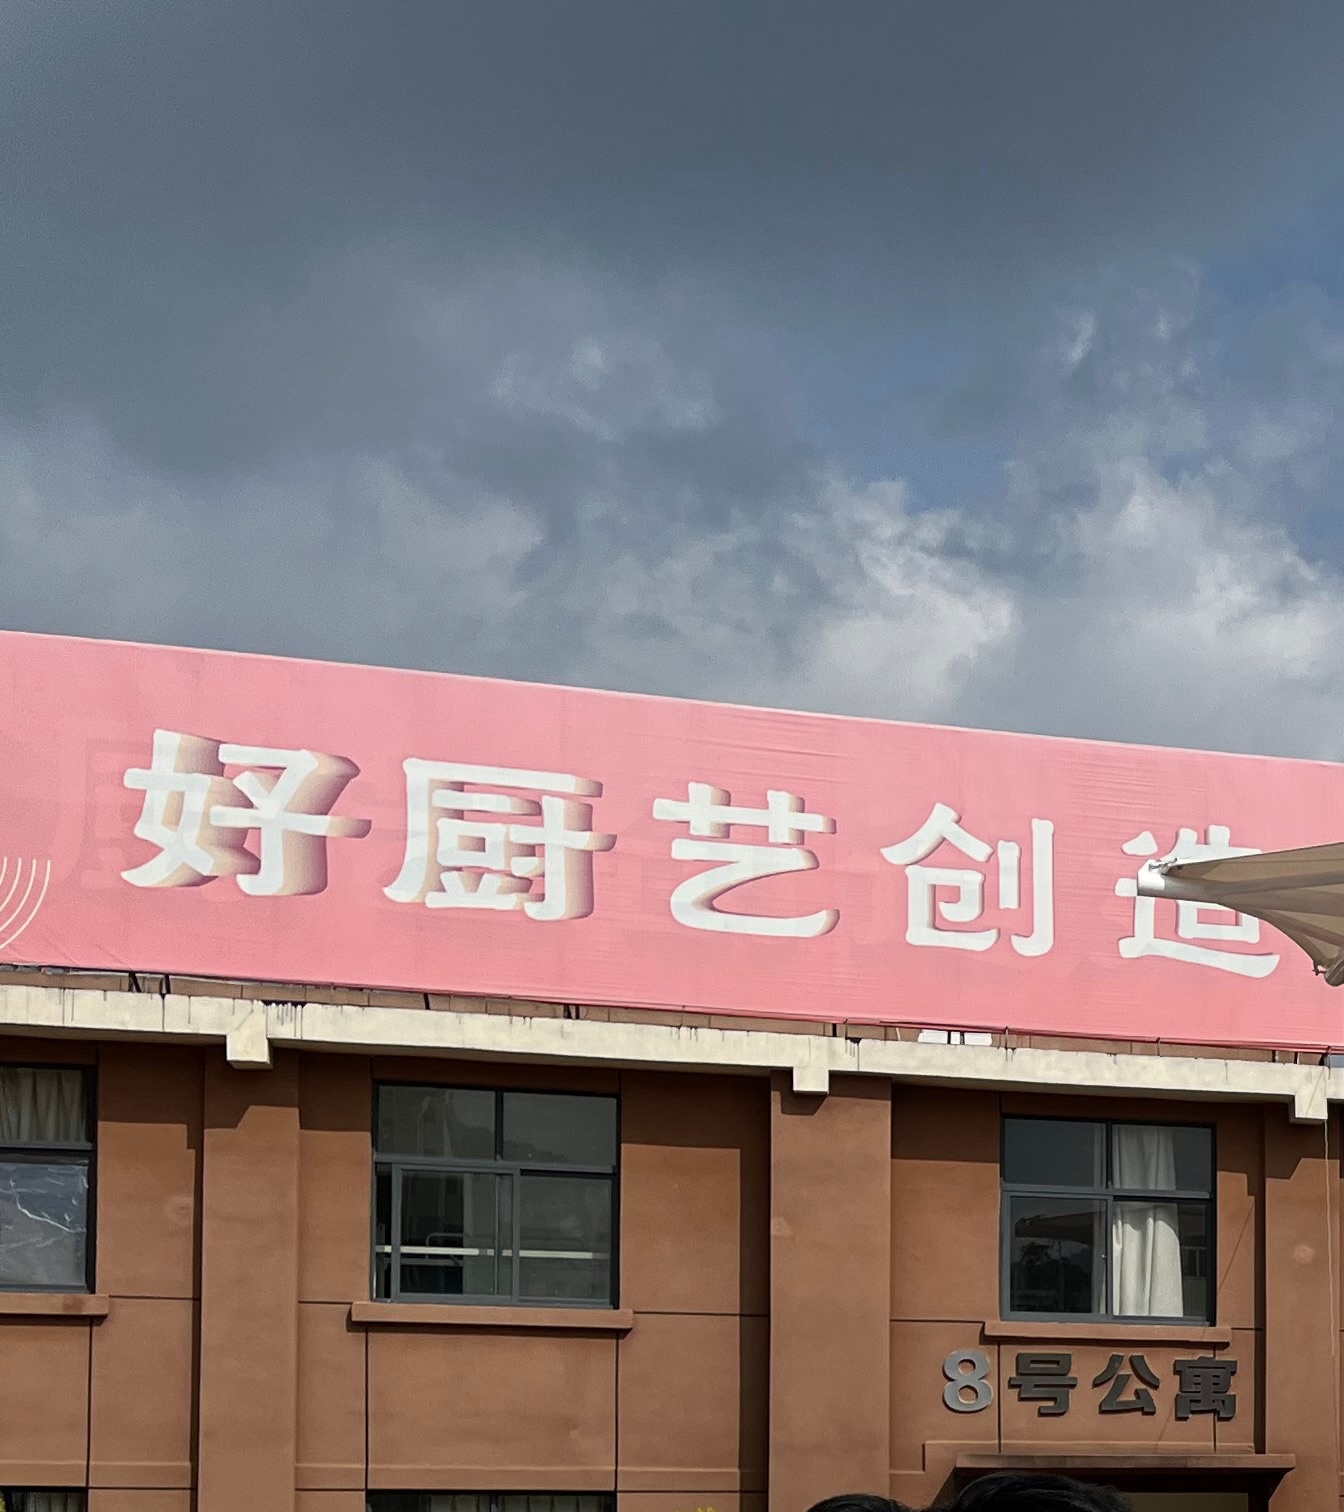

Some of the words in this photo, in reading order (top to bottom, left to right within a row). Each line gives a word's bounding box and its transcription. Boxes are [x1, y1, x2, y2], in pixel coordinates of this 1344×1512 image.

[120, 727, 1280, 978] 好厨艺创造
[943, 1350, 1238, 1422] 8号公寓
